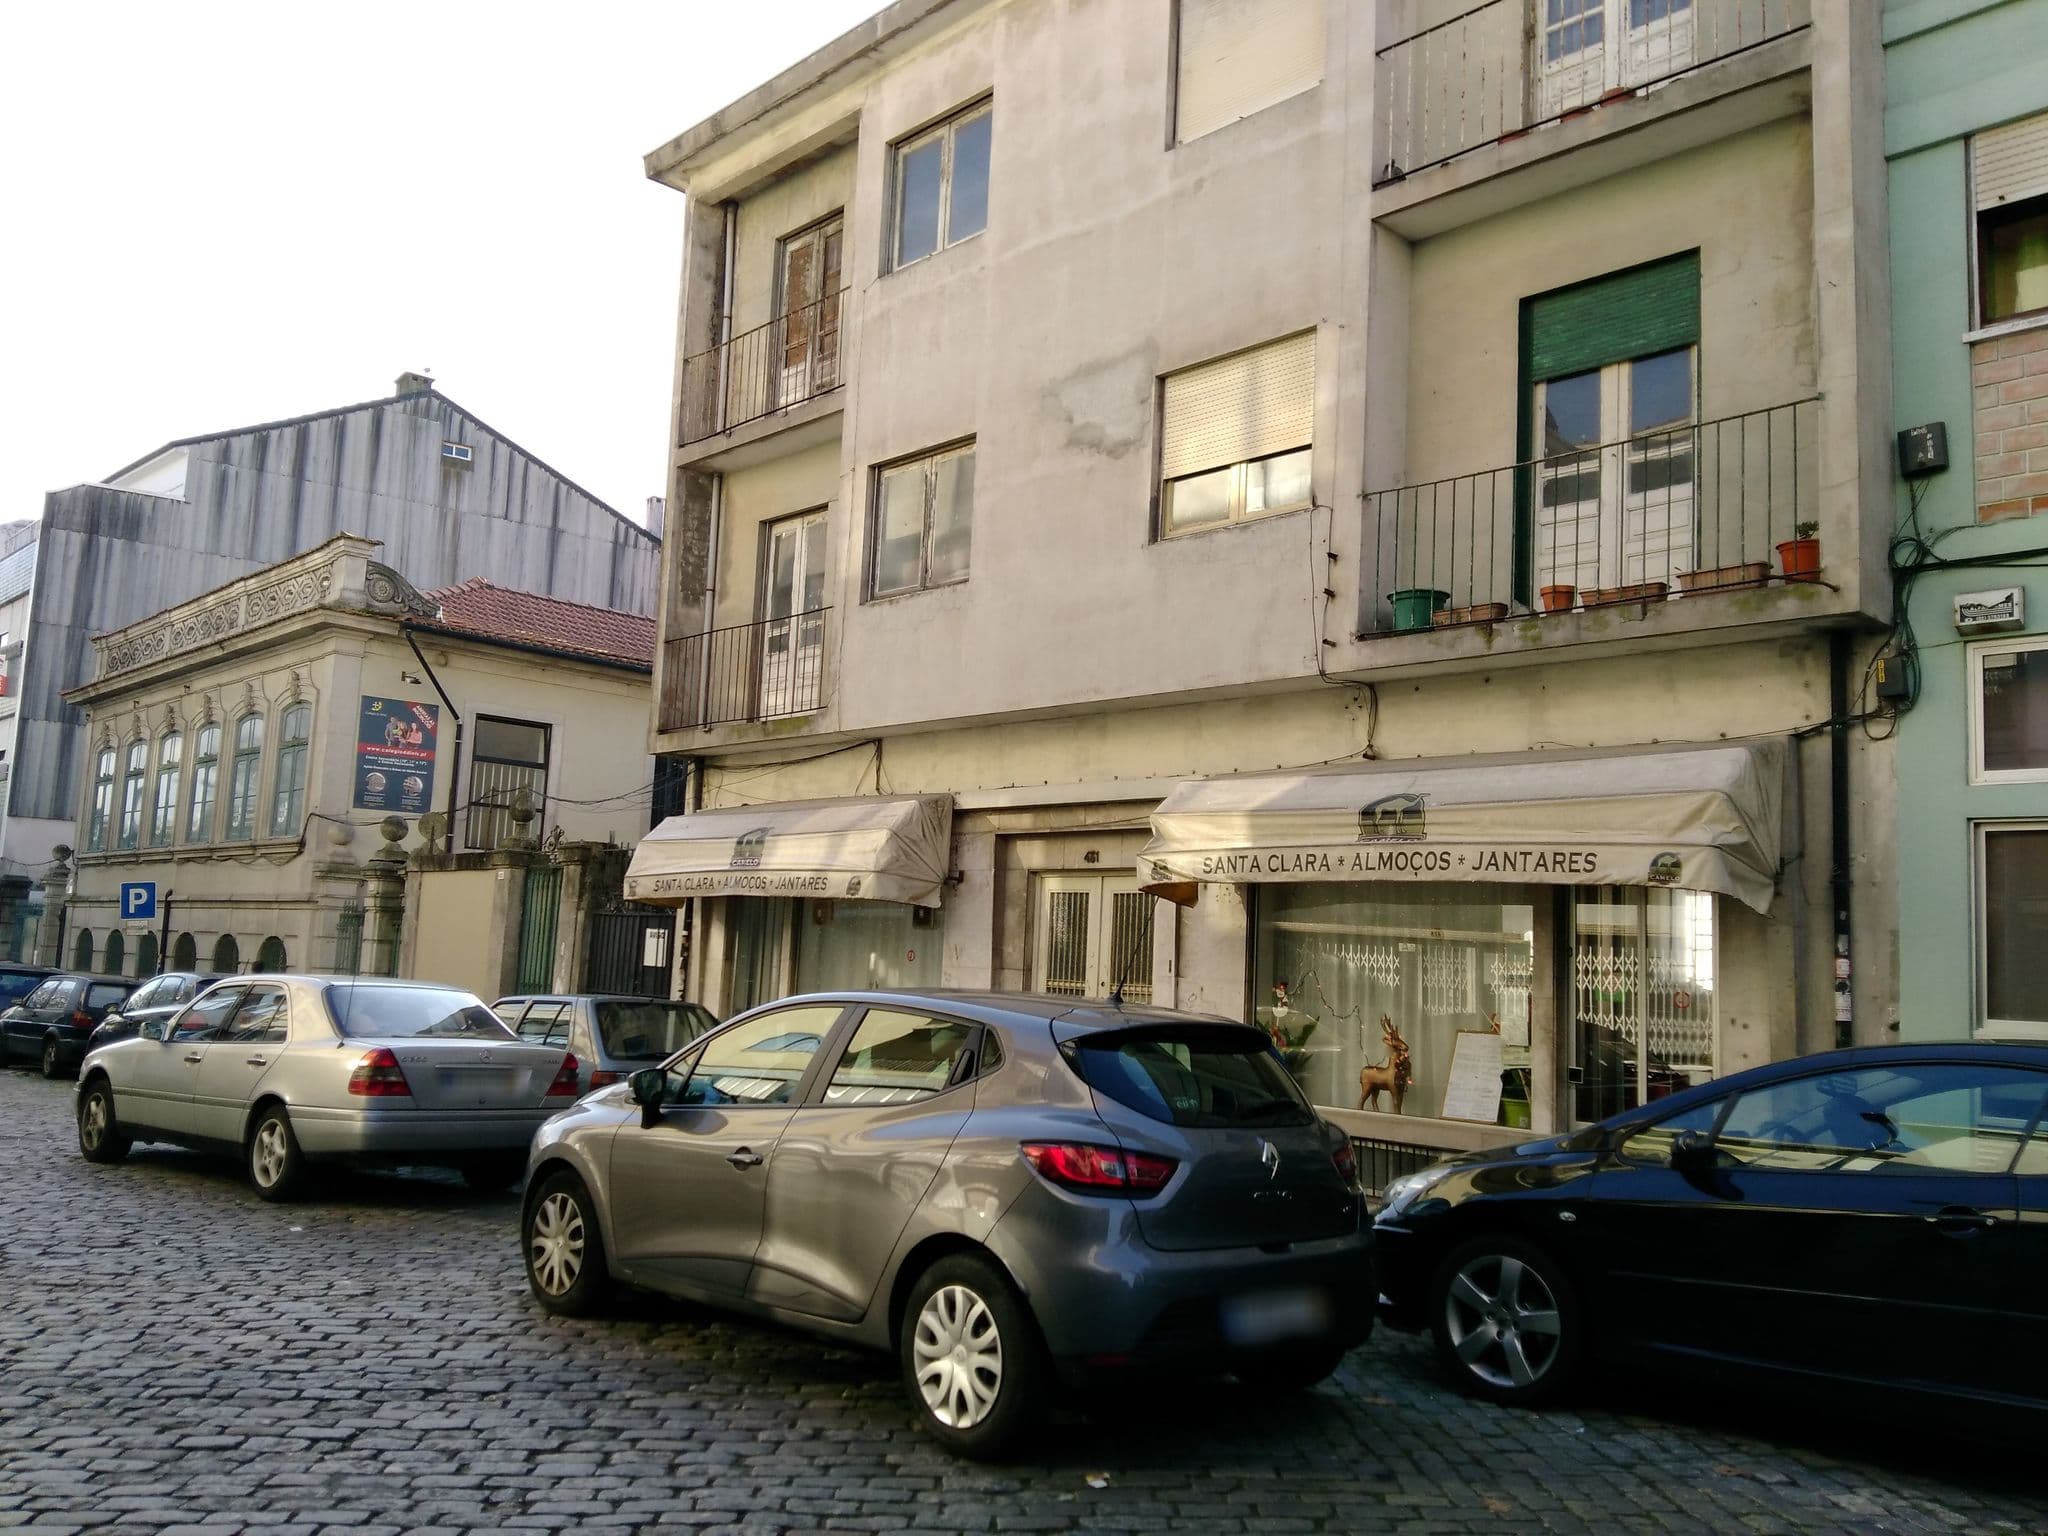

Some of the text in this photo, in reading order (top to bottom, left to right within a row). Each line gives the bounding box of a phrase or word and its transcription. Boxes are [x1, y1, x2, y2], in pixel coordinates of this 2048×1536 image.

[1202, 850, 1598, 877] SANTA CLARA ALMOÇOS JANTARES
[653, 879, 682, 892] SANTA
[684, 877, 714, 891] CLARA
[774, 876, 829, 891] JANTARES
[129, 888, 148, 914] P
